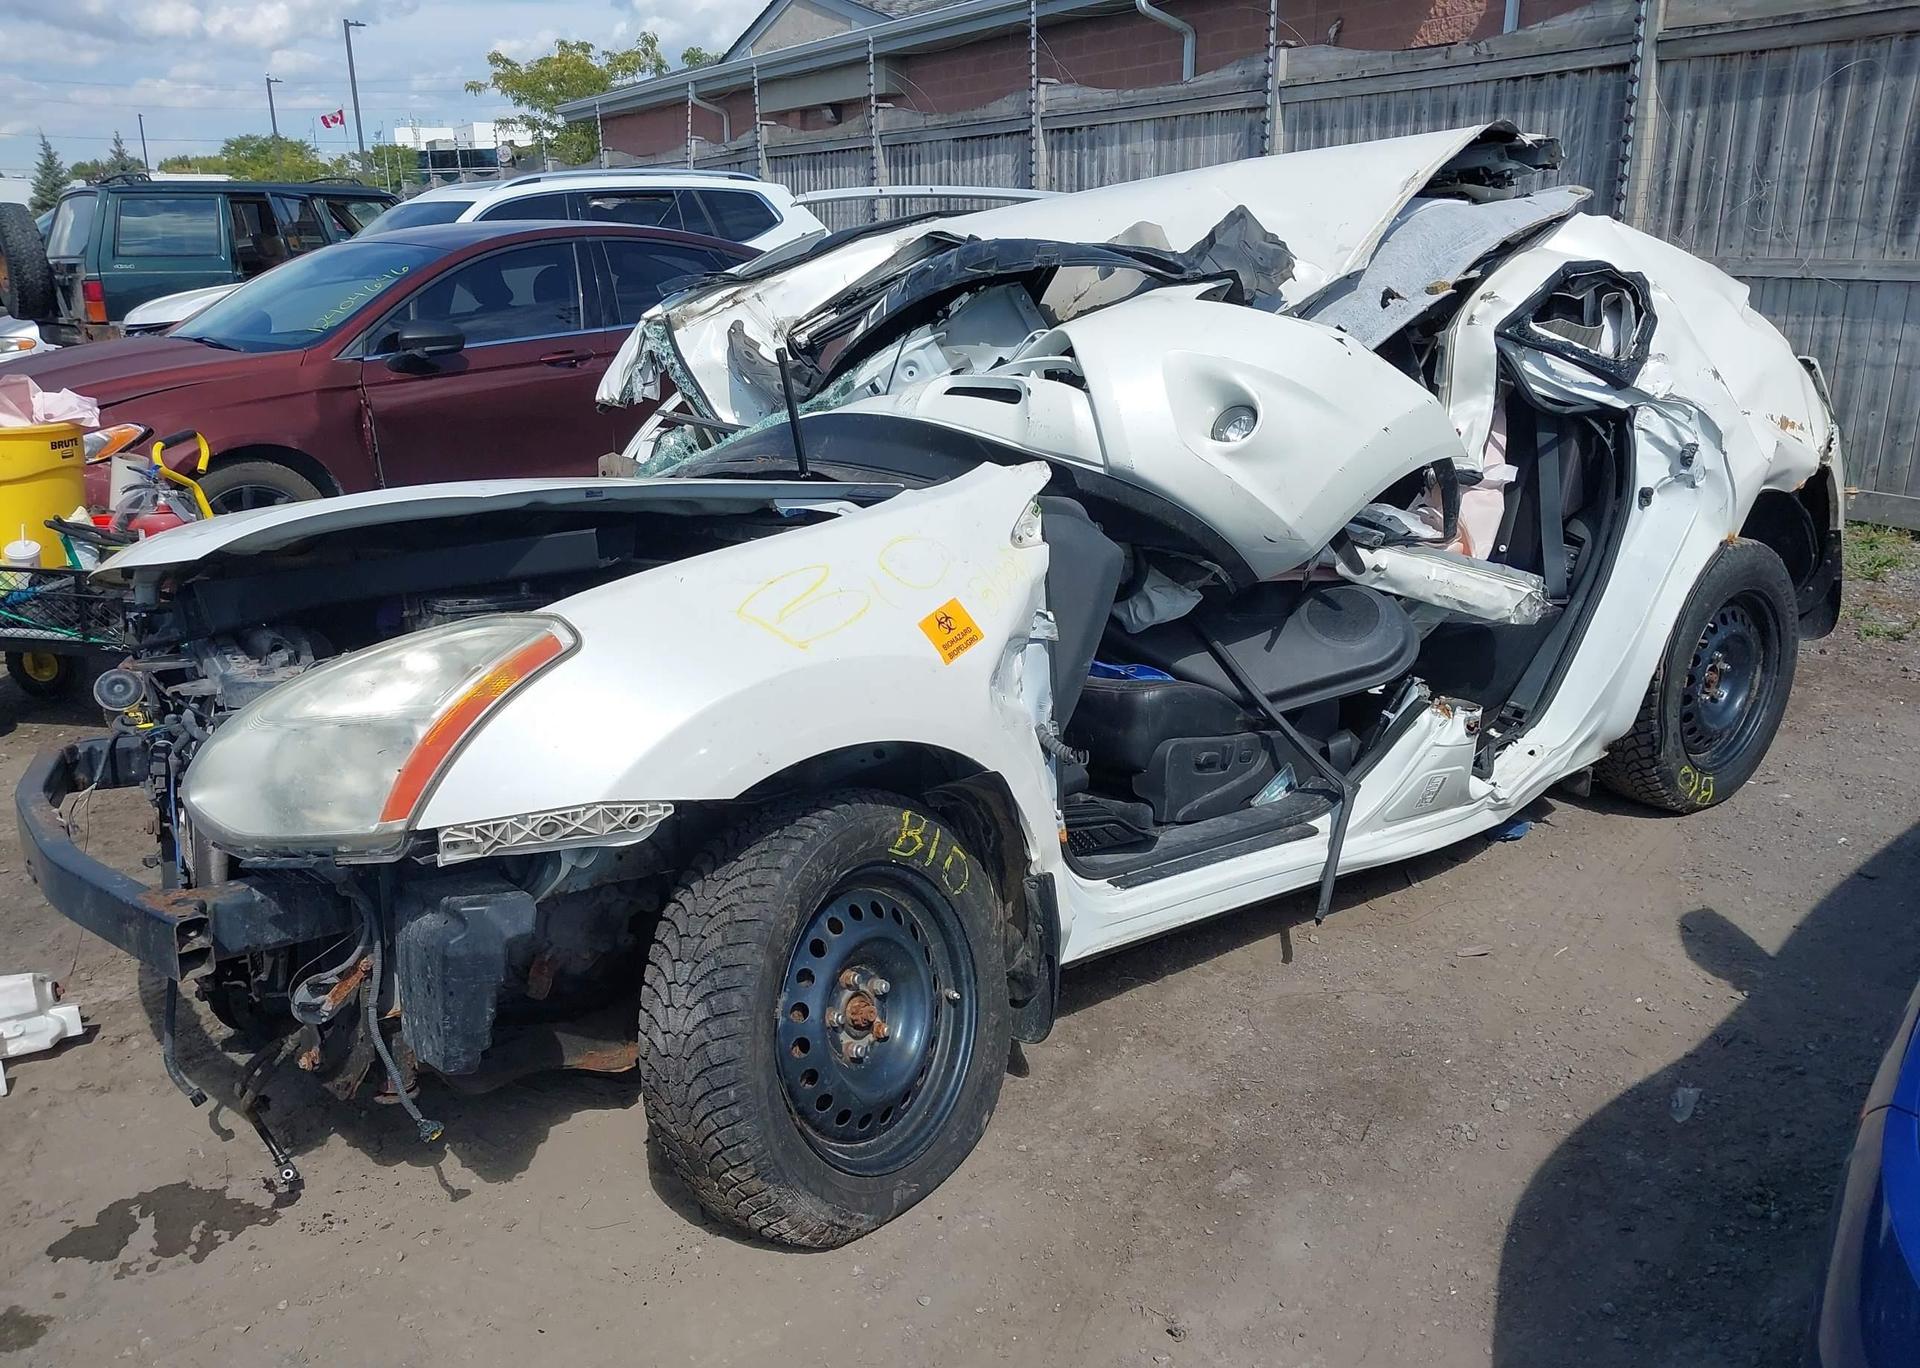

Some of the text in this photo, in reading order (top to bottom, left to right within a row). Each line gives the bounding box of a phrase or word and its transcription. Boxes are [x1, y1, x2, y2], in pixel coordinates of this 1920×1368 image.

[50, 437, 79, 450] BRUTE
[942, 626, 973, 651] BIOHAZARD
[947, 634, 979, 660] BIOPELIGRO
